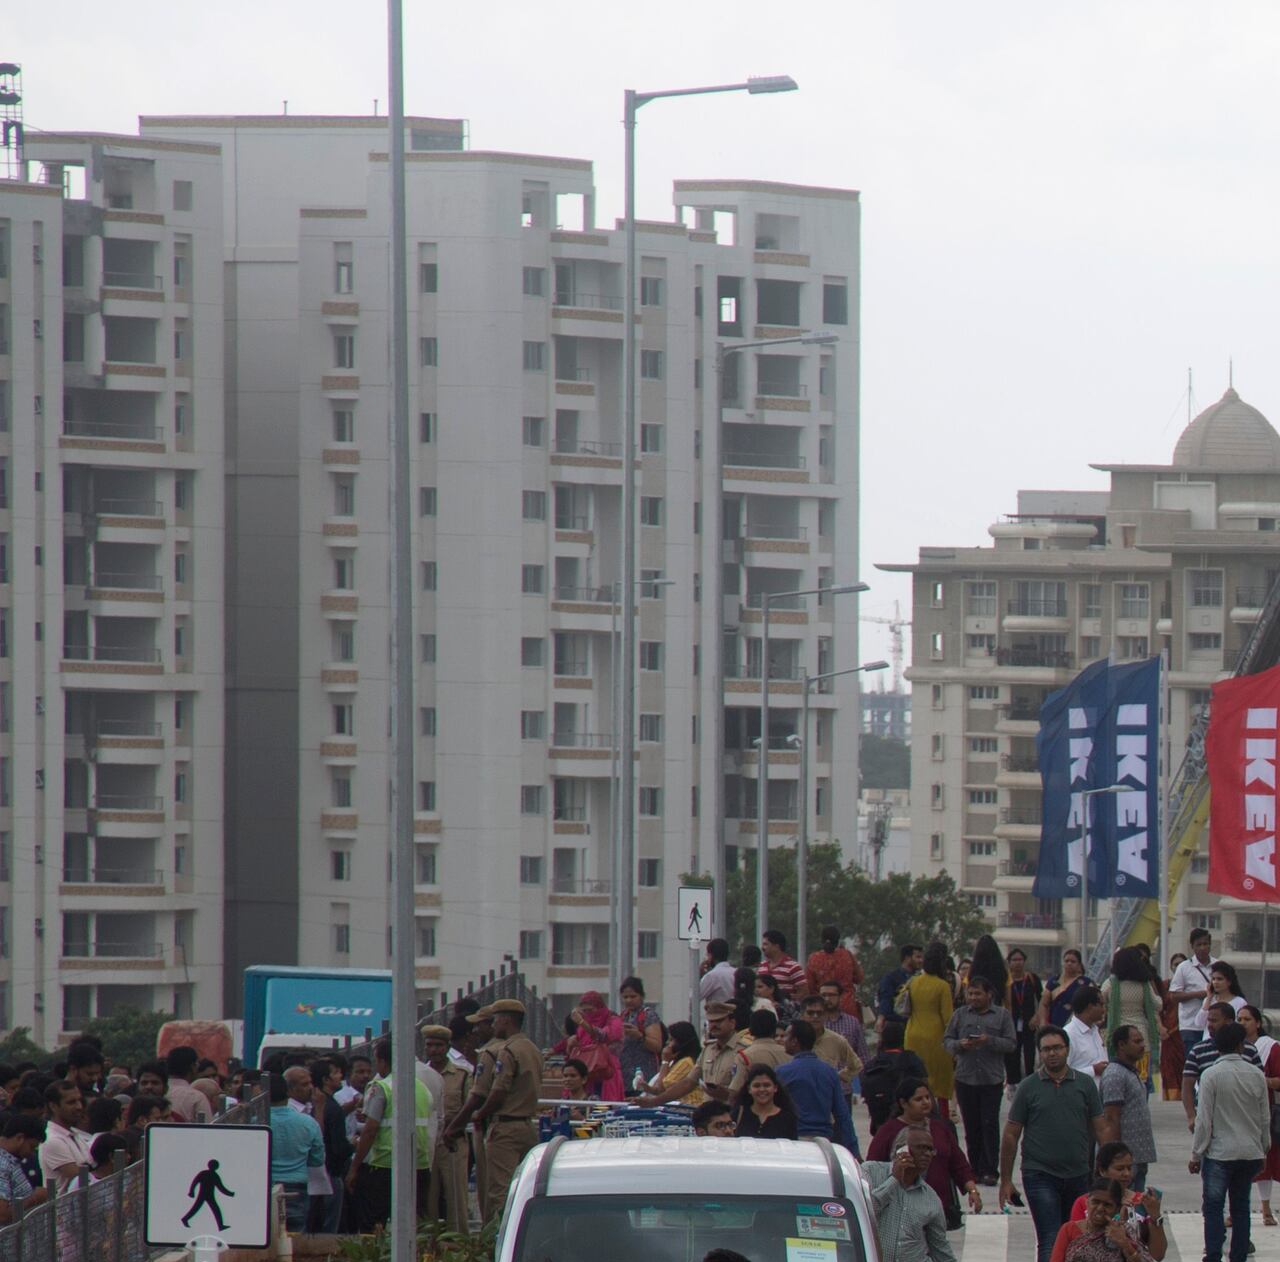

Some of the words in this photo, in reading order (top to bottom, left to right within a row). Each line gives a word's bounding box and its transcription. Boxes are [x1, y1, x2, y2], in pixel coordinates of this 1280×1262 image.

[1116, 703, 1148, 884] IKEA
[1244, 707, 1278, 888] IKEA
[316, 1006, 374, 1016] GATI
